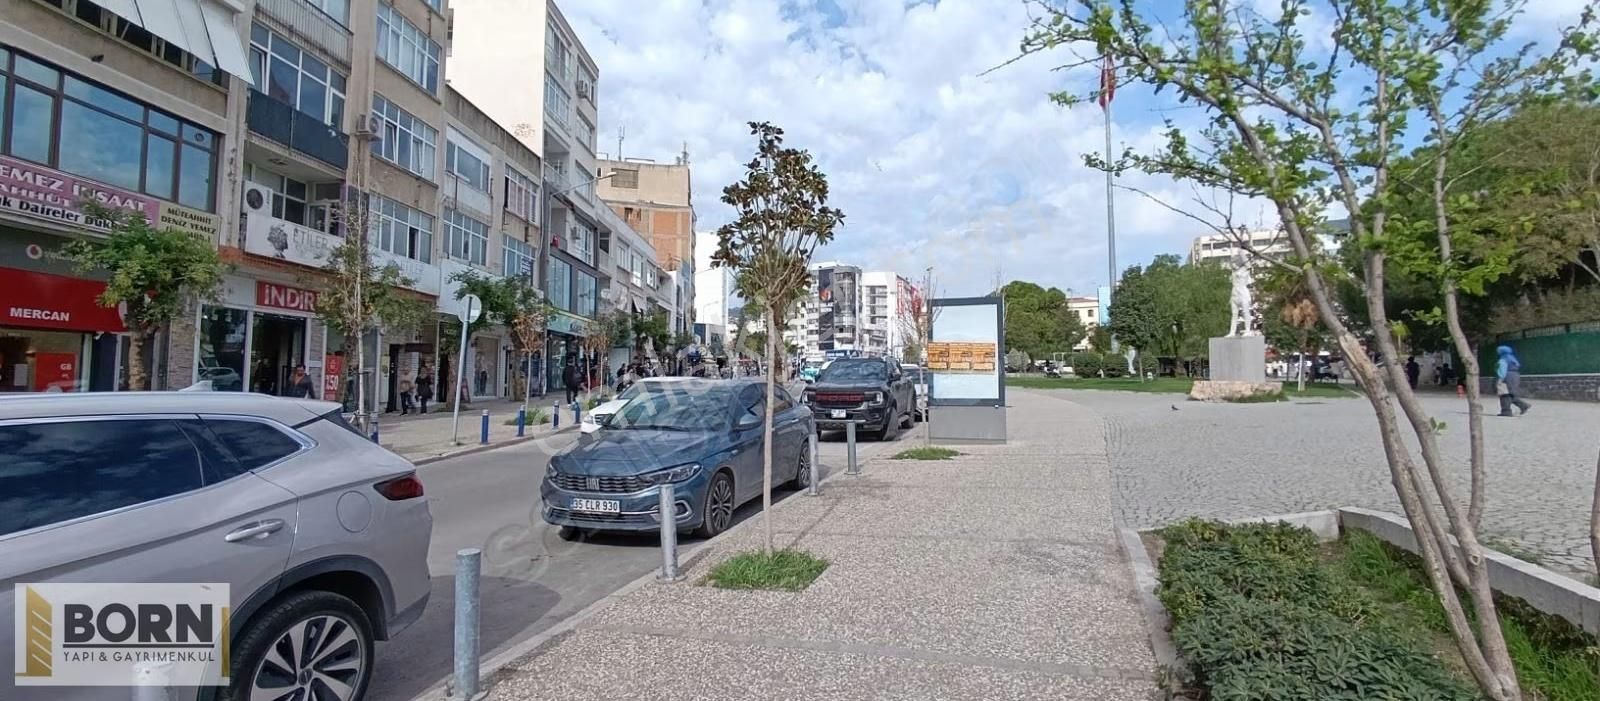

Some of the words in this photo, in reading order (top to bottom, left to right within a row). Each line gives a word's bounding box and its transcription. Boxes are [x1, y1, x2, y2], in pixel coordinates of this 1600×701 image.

[0, 165, 64, 192] EMEZ
[10, 306, 70, 322] MERCAN
[585, 500, 600, 511] CLR
[602, 500, 618, 511] 930
